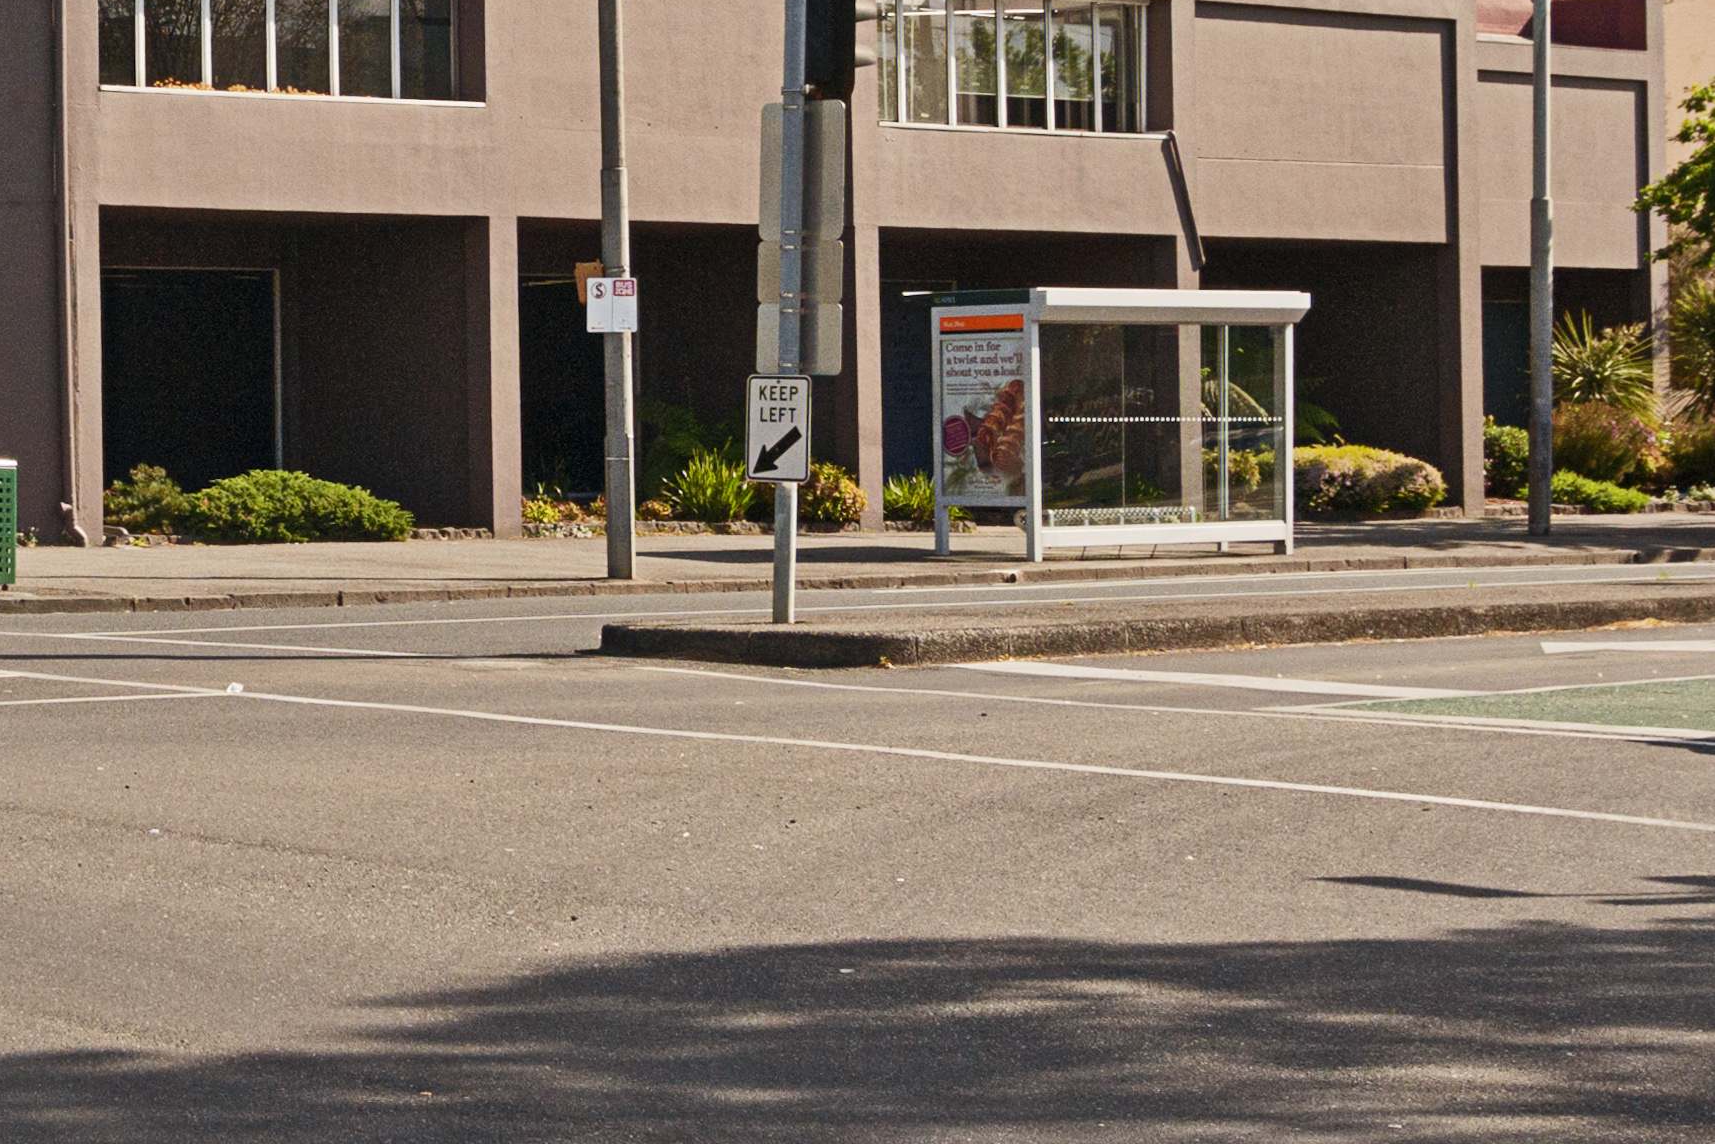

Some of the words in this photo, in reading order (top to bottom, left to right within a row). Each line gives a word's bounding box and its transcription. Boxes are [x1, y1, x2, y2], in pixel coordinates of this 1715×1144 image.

[615, 288, 633, 296] ZONE
[945, 343, 973, 352] Come
[974, 342, 984, 351] in
[986, 341, 1001, 351] for
[953, 354, 978, 364] twist
[980, 353, 997, 364] and
[1000, 352, 1023, 364] we'll
[946, 367, 971, 377] shout
[974, 368, 991, 379] you
[758, 385, 799, 401] KEEP
[759, 407, 796, 423] LEFT
